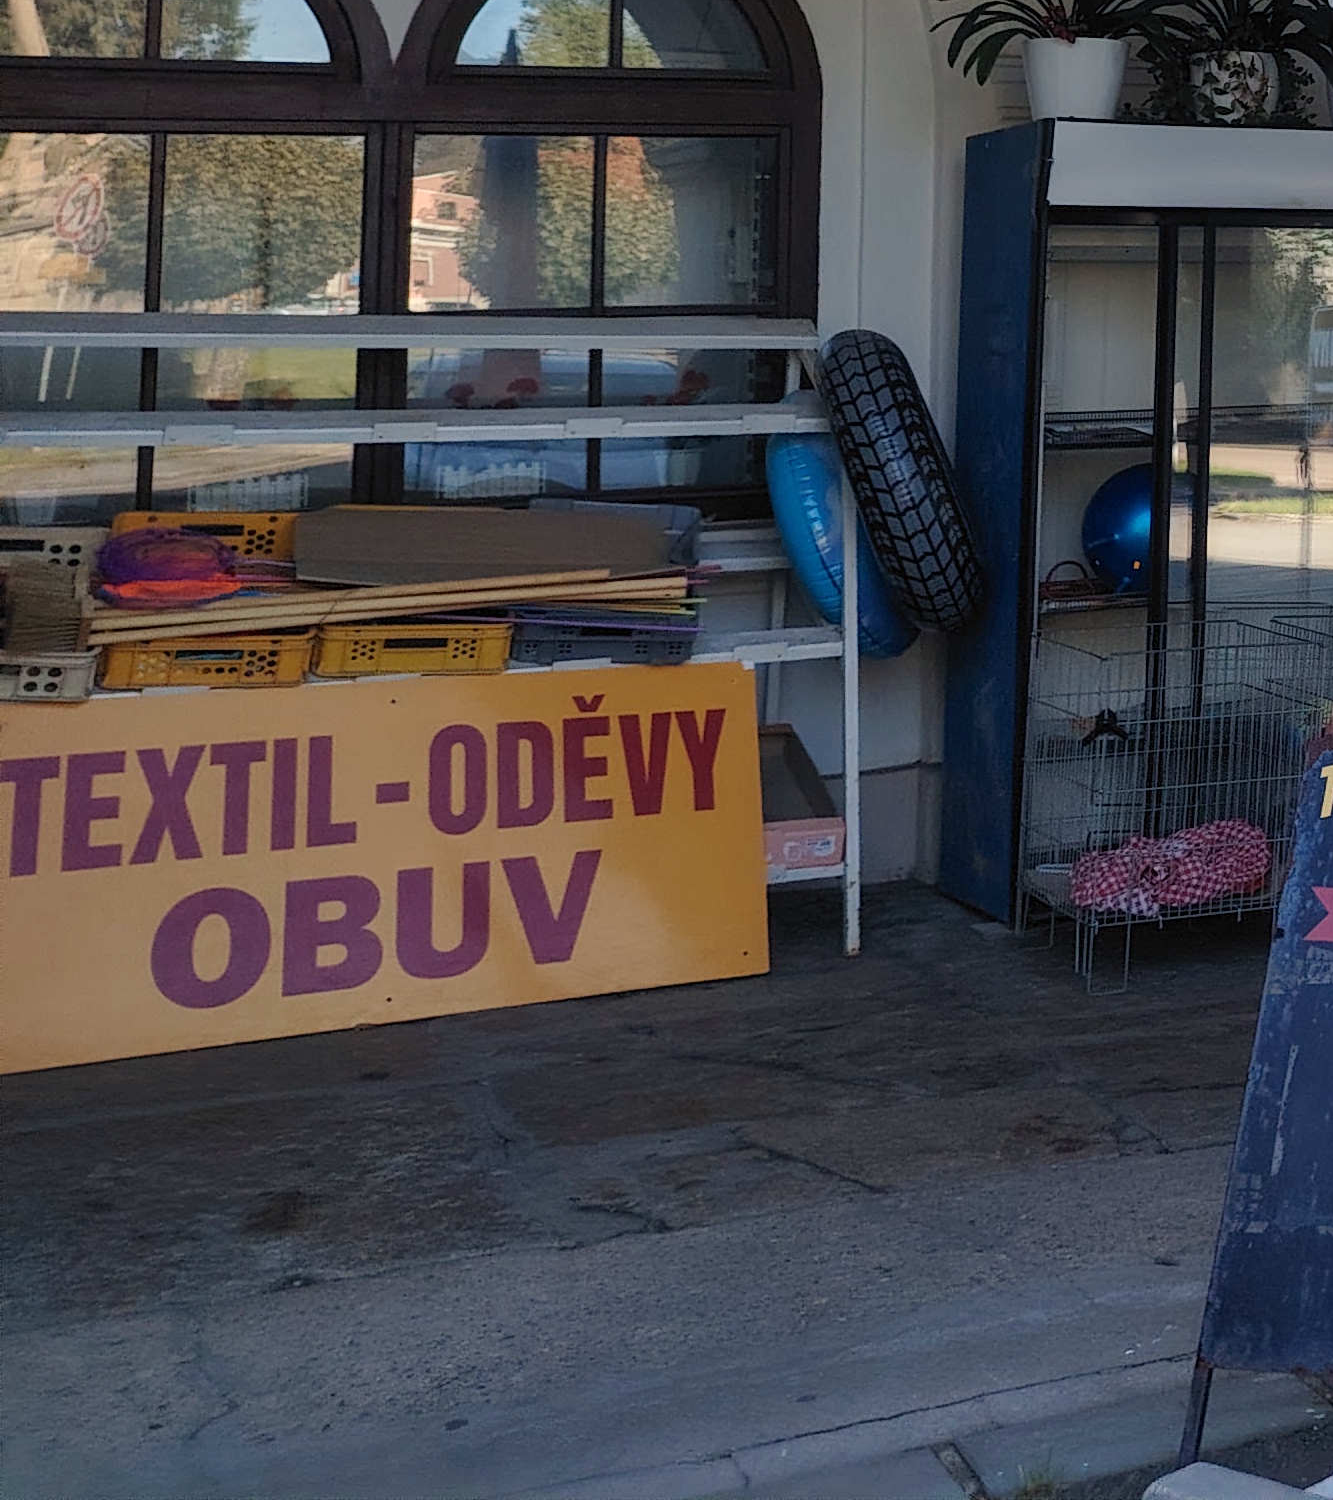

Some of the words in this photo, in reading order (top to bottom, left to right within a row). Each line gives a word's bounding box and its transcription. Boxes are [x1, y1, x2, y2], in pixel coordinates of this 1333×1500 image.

[0, 736, 358, 878] TEXTIL
[428, 694, 728, 837] ODĚVY
[150, 849, 603, 1010] OBUV
